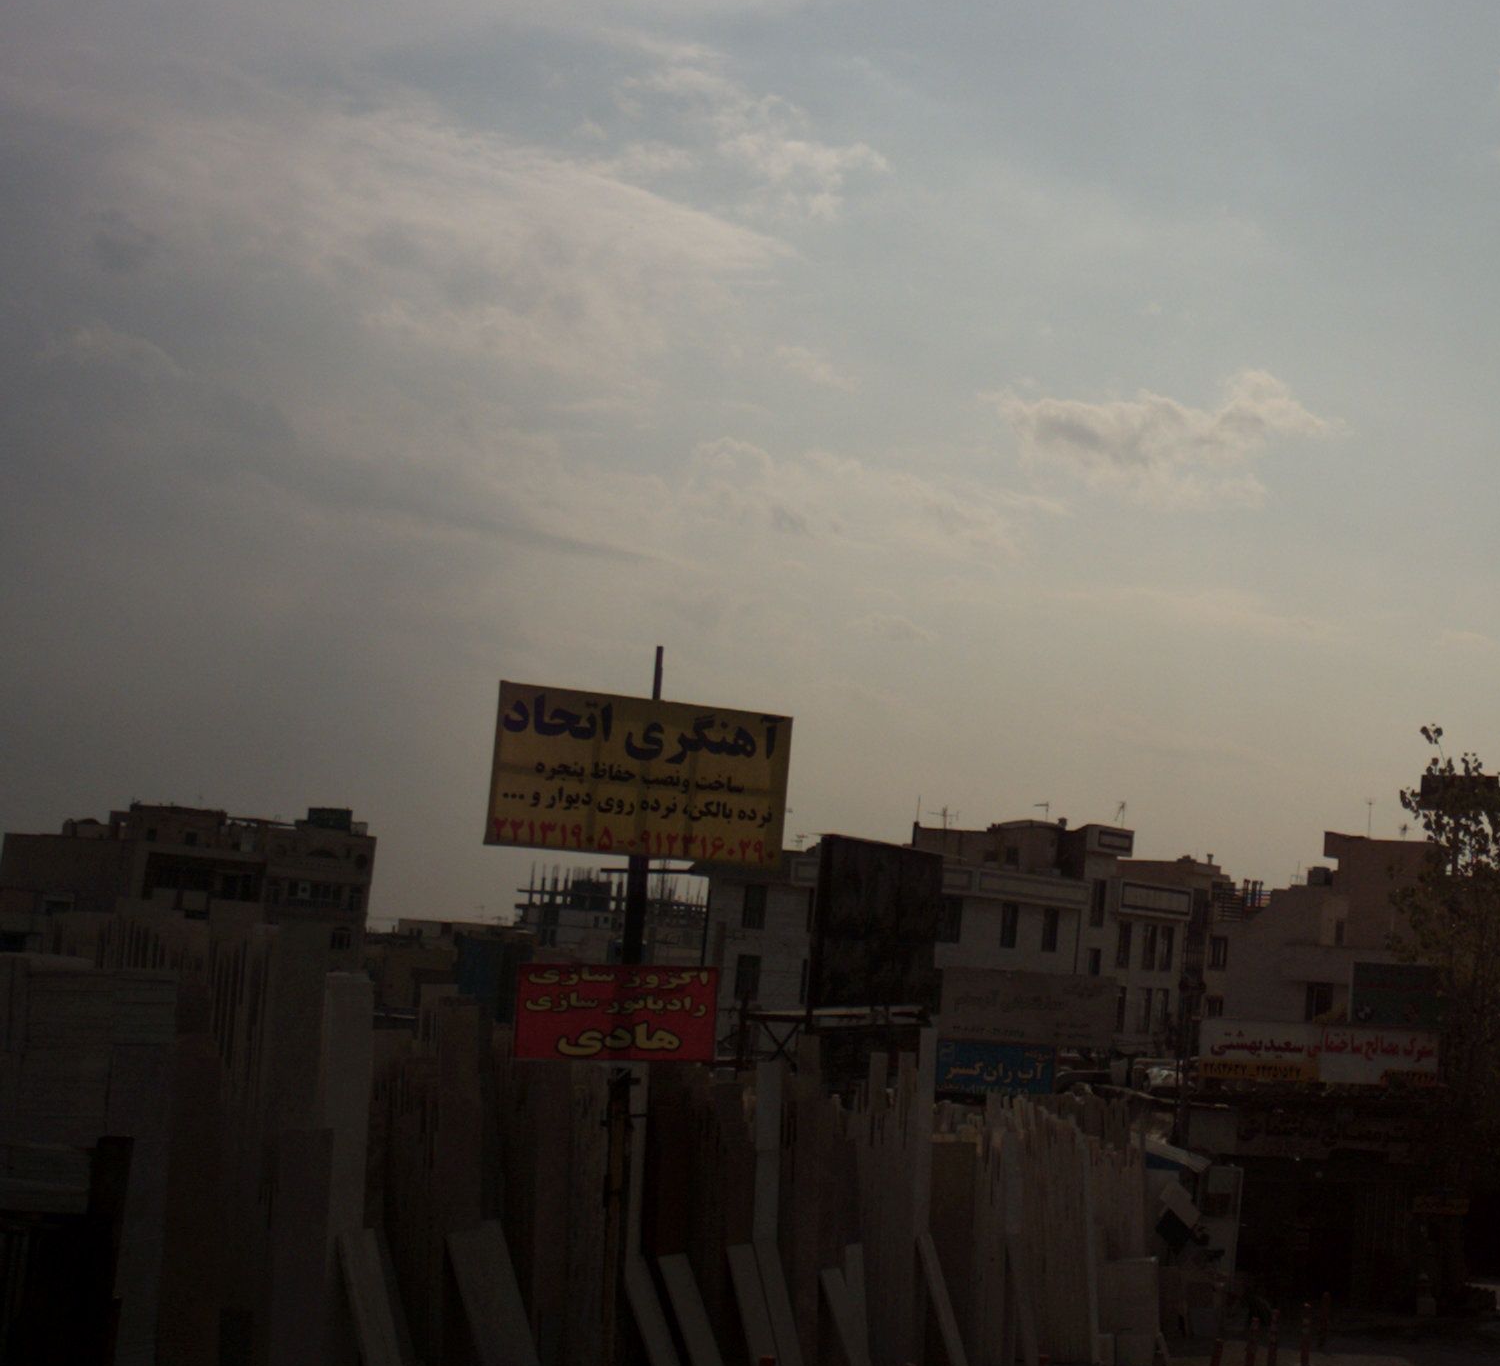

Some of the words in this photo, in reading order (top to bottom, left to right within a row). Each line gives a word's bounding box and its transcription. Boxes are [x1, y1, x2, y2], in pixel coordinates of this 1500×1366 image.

[624, 715, 786, 765] آهنگری
[534, 761, 586, 783] پنجره
[590, 760, 637, 783] حفاظ
[694, 775, 745, 794] ساخت
[546, 786, 593, 810] دیوار
[596, 794, 636, 816] روی
[641, 795, 678, 819] نرده
[738, 807, 774, 829] نرده
[527, 965, 616, 987] سازی
[525, 990, 600, 1013] سازی
[604, 994, 708, 1018] رادیاتور
[555, 1019, 682, 1058] هادی
[1209, 1030, 1263, 1058] بهشتی
[1265, 1037, 1304, 1059] سعید
